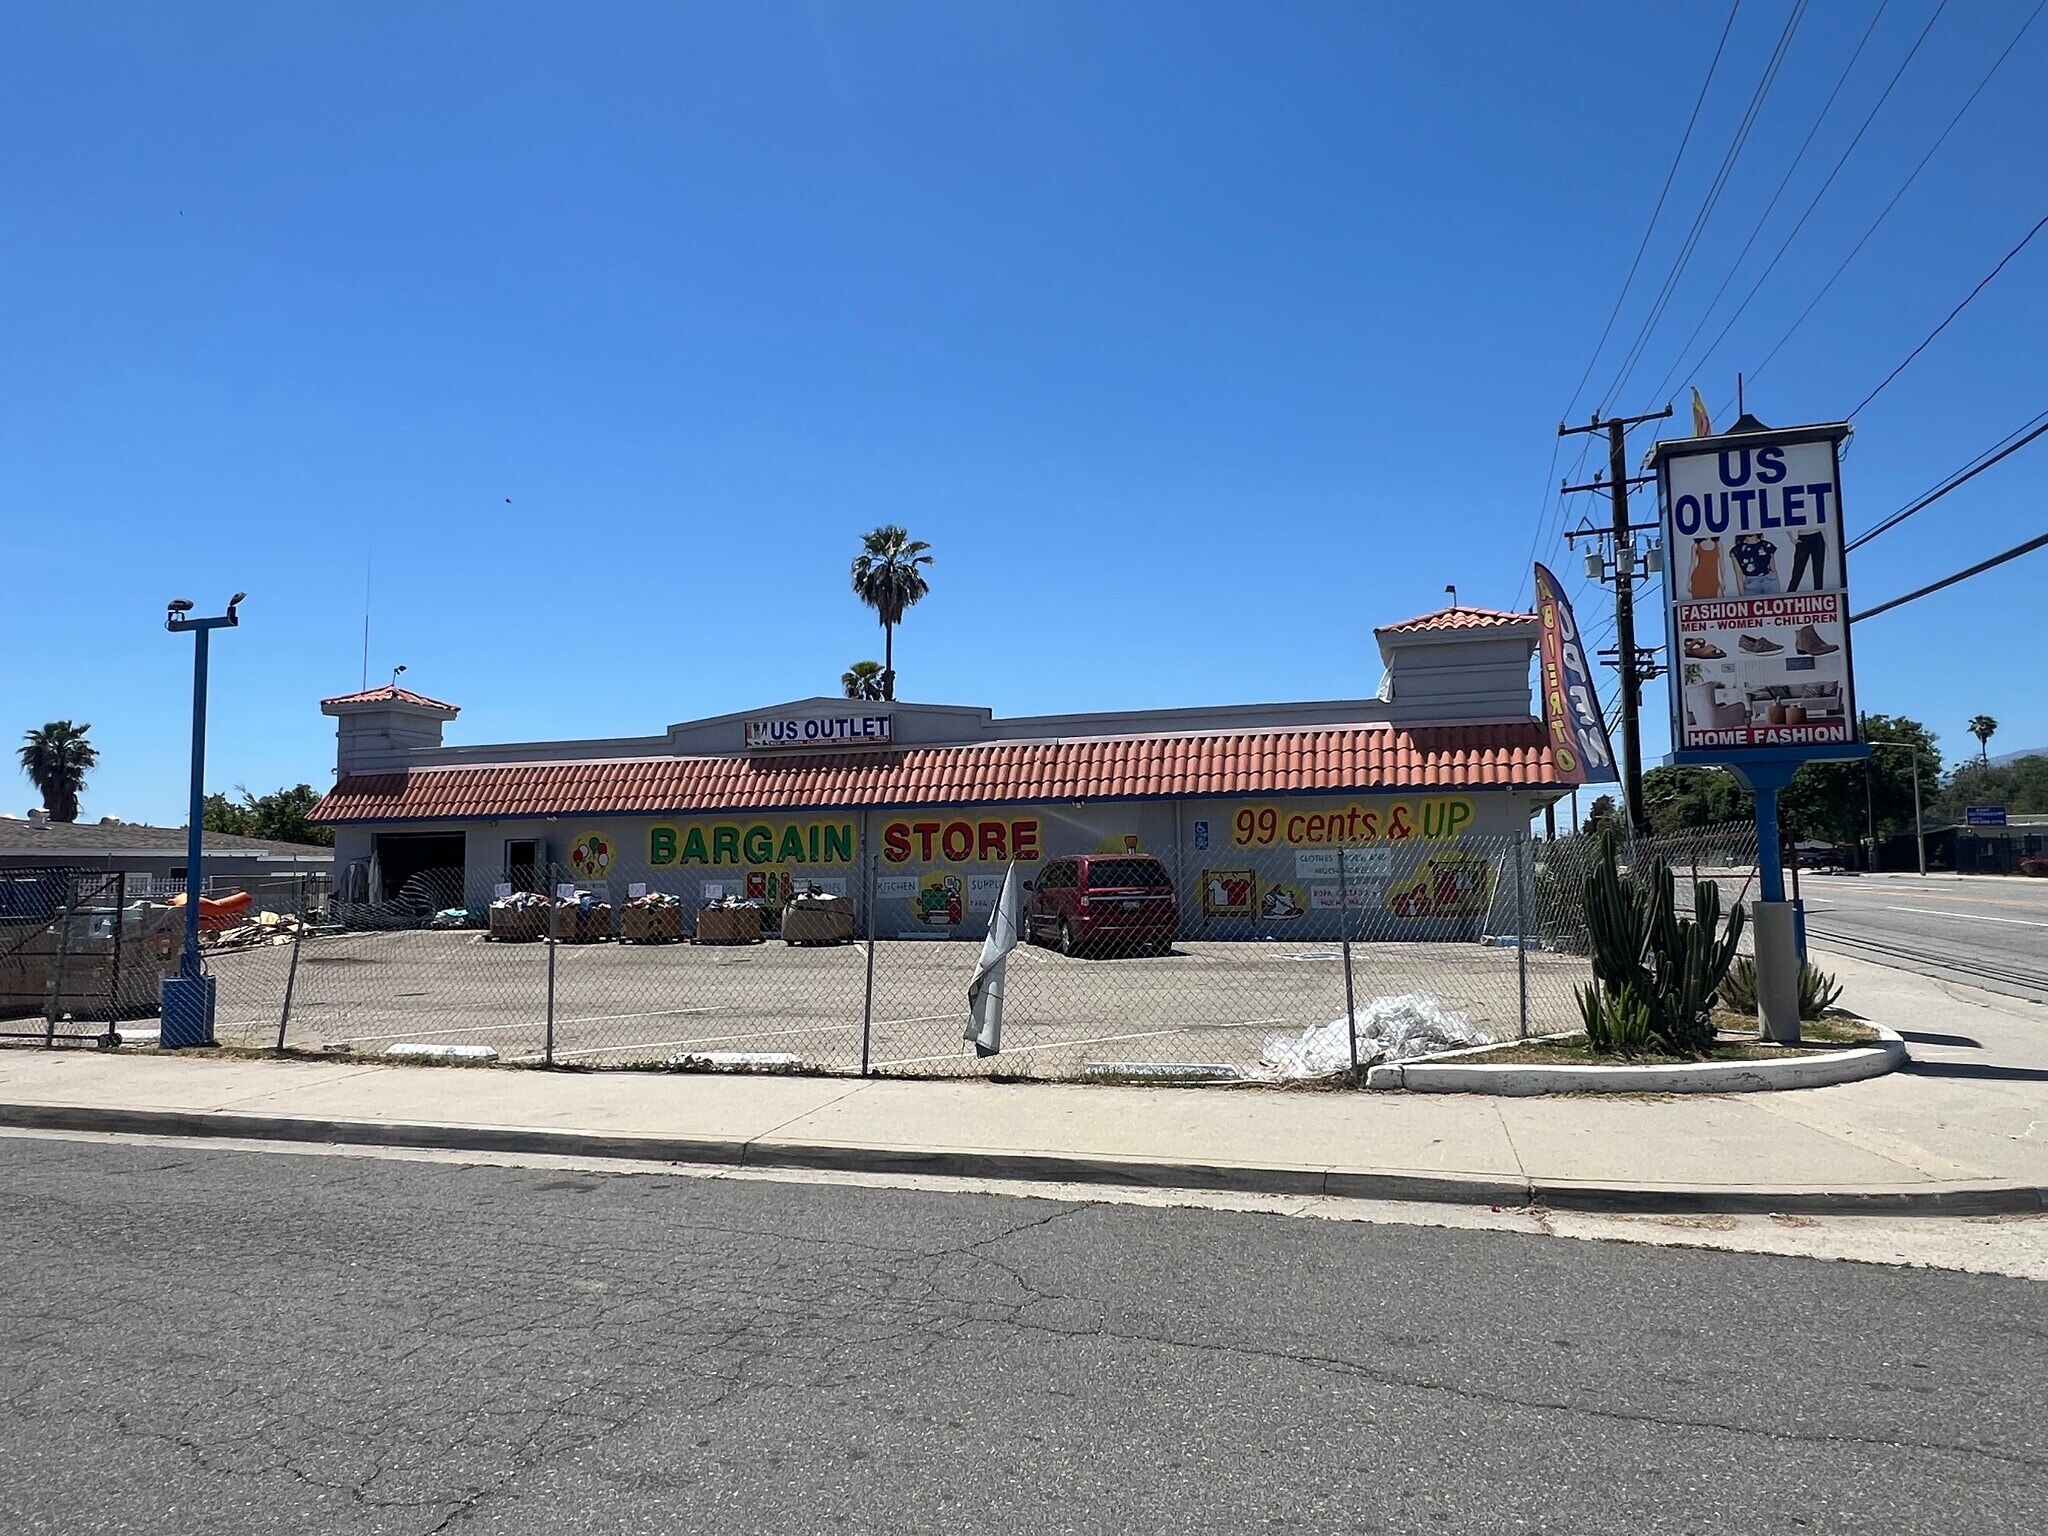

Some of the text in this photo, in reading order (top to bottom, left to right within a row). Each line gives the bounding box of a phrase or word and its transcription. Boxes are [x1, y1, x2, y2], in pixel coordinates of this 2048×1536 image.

[1718, 446, 1787, 487] US
[1675, 483, 1832, 536] OUTLET
[1681, 594, 1836, 622] FASHION CLOTHING
[1681, 621, 1707, 632] MEN
[1717, 618, 1764, 630] WOMEN
[1774, 613, 1838, 626] CHILDREN
[770, 721, 799, 741] US
[804, 717, 888, 739] OUTLET
[1689, 726, 1844, 746] HOME FASHION
[1235, 801, 1470, 845] 99 cents & UP
[650, 820, 1041, 865] BARGAIN STORE
[1299, 854, 1333, 863] CLOTHES
[877, 881, 916, 891] KITCHEN
